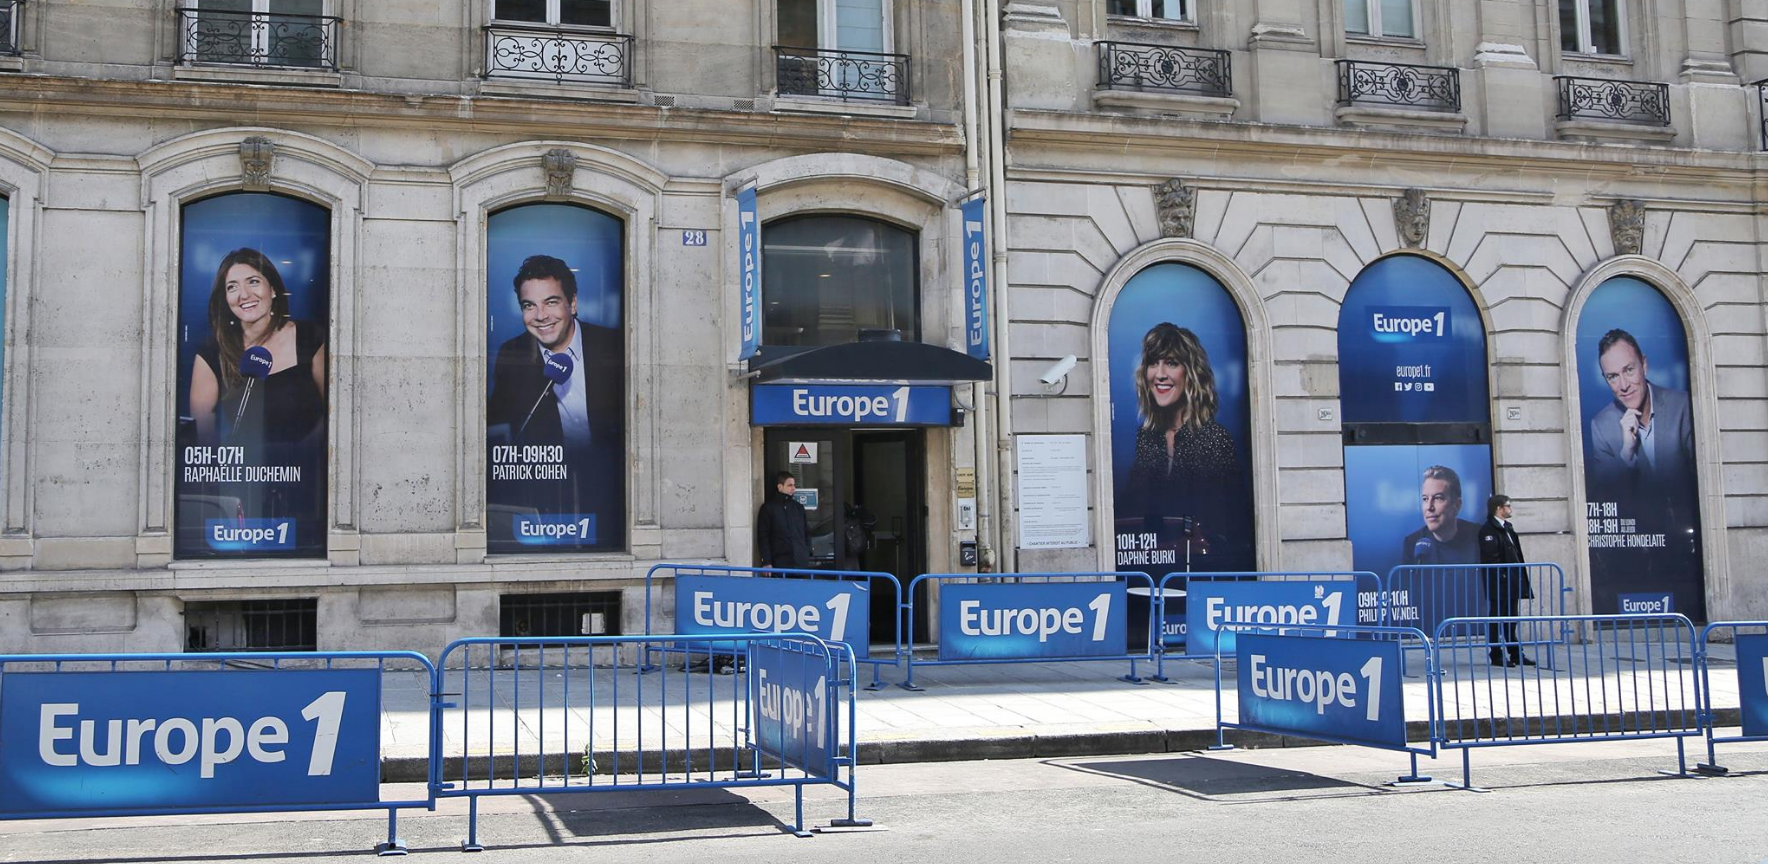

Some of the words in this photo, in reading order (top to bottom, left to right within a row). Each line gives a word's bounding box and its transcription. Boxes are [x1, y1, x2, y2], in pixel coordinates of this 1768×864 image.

[741, 211, 754, 231] 1
[966, 220, 982, 239] 1
[685, 230, 704, 245] 28
[744, 232, 754, 342] Europe
[970, 241, 983, 346] Europe
[1373, 313, 1432, 336] Europe
[1433, 311, 1445, 336] 1
[1396, 364, 1431, 379] europe1.fr
[793, 389, 888, 422] Europe
[892, 386, 910, 422] 1
[184, 446, 244, 465] 05H-07H
[492, 445, 564, 463] 07H-09H30
[184, 464, 242, 482] RAPHAËLLE
[245, 466, 301, 482] DUCHEMIN
[492, 464, 533, 480] PATRICK
[534, 464, 567, 480] COHEN
[1586, 502, 1617, 517] 7H-18H
[213, 525, 274, 544] Europe
[276, 522, 289, 544] 1
[520, 520, 577, 539] Europe
[578, 518, 590, 539] 1
[1587, 518, 1619, 534] 8H-19H
[1116, 533, 1157, 550] 10H-12H
[1627, 534, 1665, 547] HONDELATTE
[1117, 547, 1150, 566] DAPHNÉ
[1151, 549, 1176, 565] BURKI
[1206, 597, 1318, 636] Europe
[1321, 591, 1343, 637] 1
[1391, 606, 1420, 621] VANDEL
[1623, 599, 1661, 614] Europe
[1661, 596, 1670, 614] 1
[694, 591, 820, 633] Europe
[826, 592, 851, 642] 1
[960, 600, 1084, 643] Europe
[1088, 593, 1112, 641] 1
[1250, 654, 1357, 715] Europe
[1360, 656, 1383, 721] 1
[814, 675, 826, 750] 1
[38, 703, 290, 779] Europe
[301, 691, 347, 776] 1
